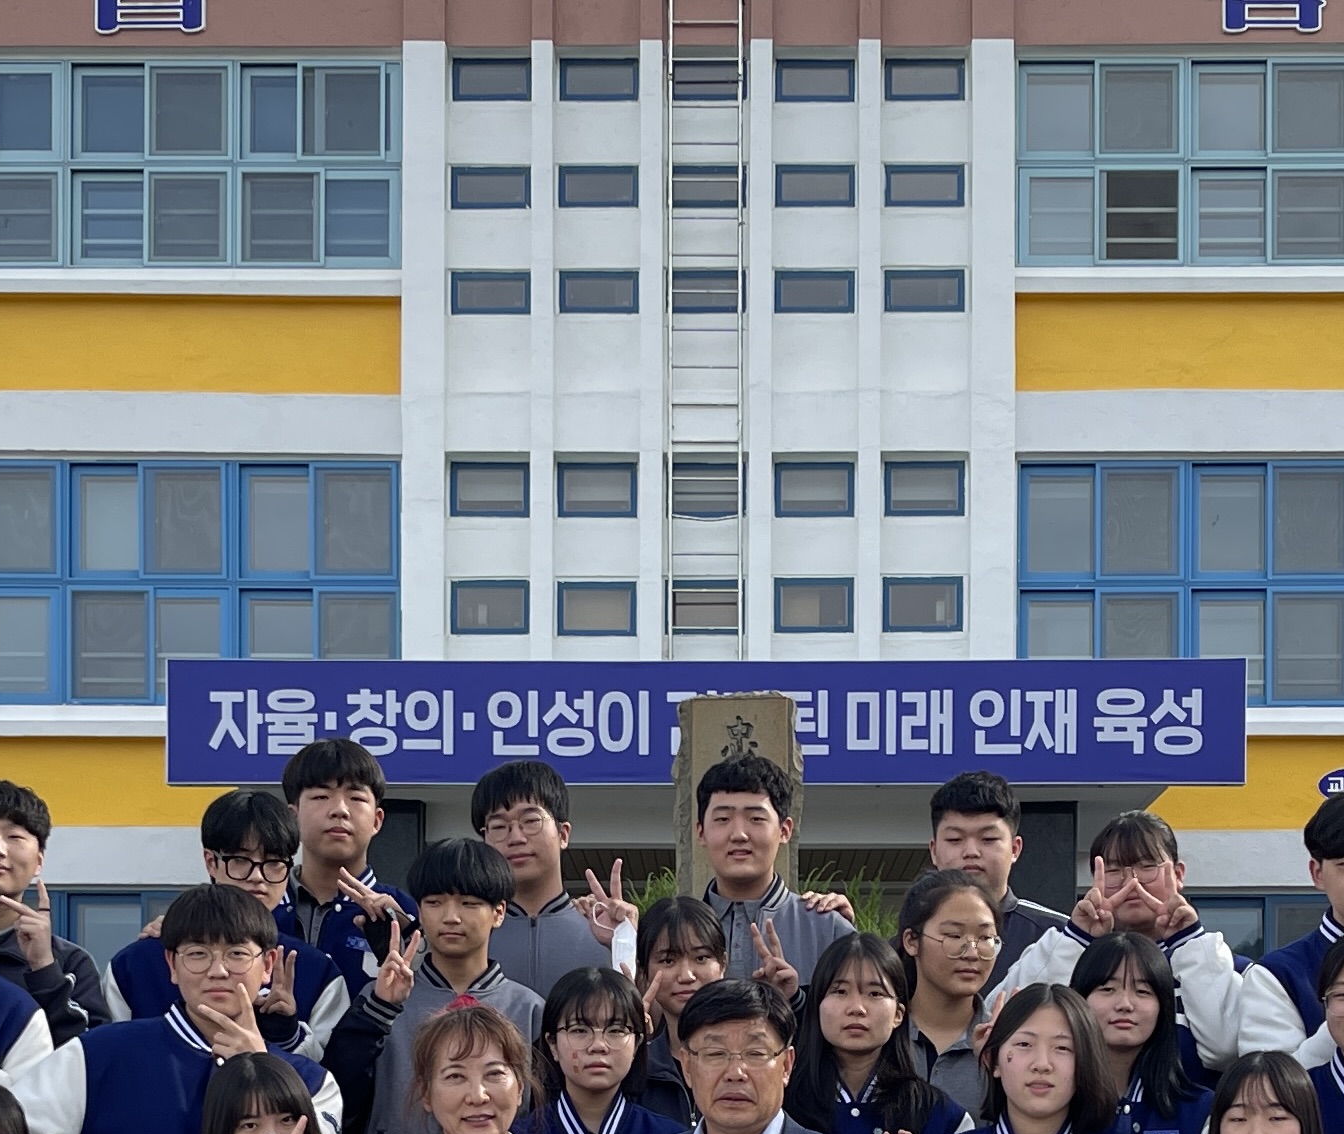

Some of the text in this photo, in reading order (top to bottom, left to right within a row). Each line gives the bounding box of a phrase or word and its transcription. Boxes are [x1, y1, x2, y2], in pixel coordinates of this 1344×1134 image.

[846, 688, 953, 756] 미래
[969, 688, 1077, 756] 인재
[1093, 687, 1204, 756] 육성
